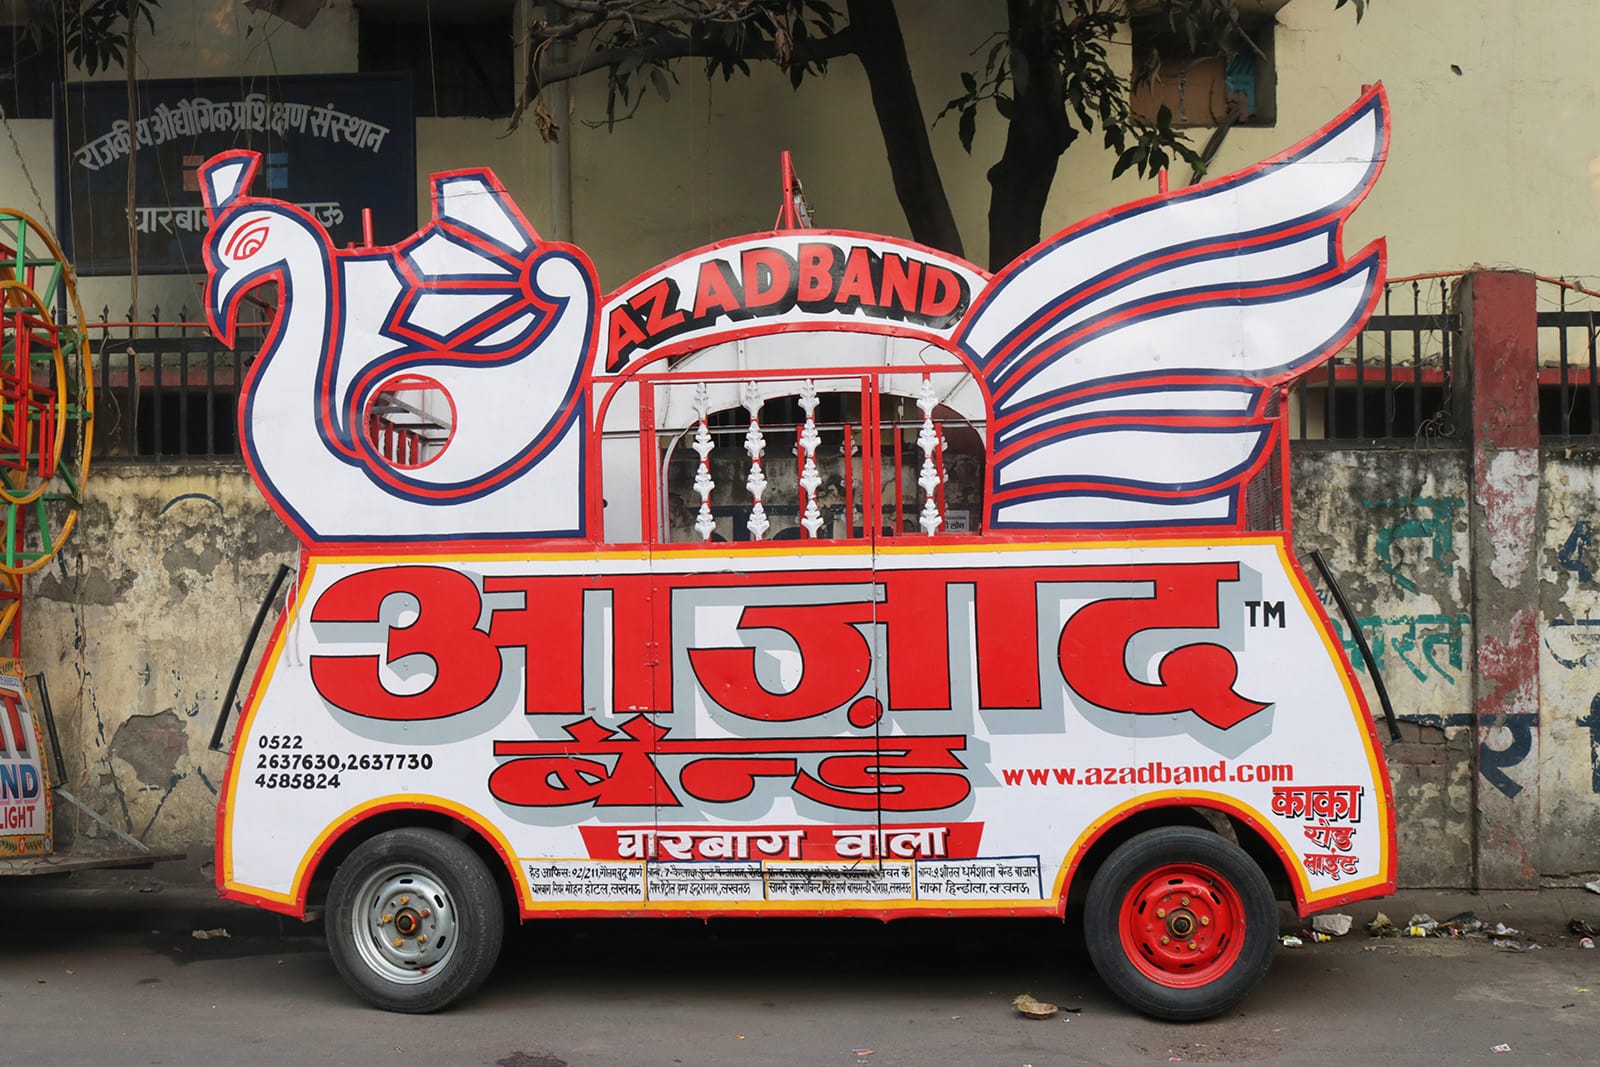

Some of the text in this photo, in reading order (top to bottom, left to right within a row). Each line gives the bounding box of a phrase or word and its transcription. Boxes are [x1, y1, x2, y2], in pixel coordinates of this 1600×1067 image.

[309, 103, 391, 153] संस्थान
[1244, 601, 1286, 628] TM
[258, 735, 303, 749] 0522
[257, 754, 433, 774] 2637630,2637730
[1002, 760, 1293, 786] www.azadband.com
[255, 773, 341, 789] 4585824
[1271, 785, 1364, 822] काका
[616, 826, 950, 860] चारबाग वाला
[1303, 818, 1356, 853] रोड
[528, 864, 540, 880] हेड
[961, 864, 995, 880] धर्मशाला
[565, 881, 583, 896] मोहन
[919, 881, 943, 894] नाका
